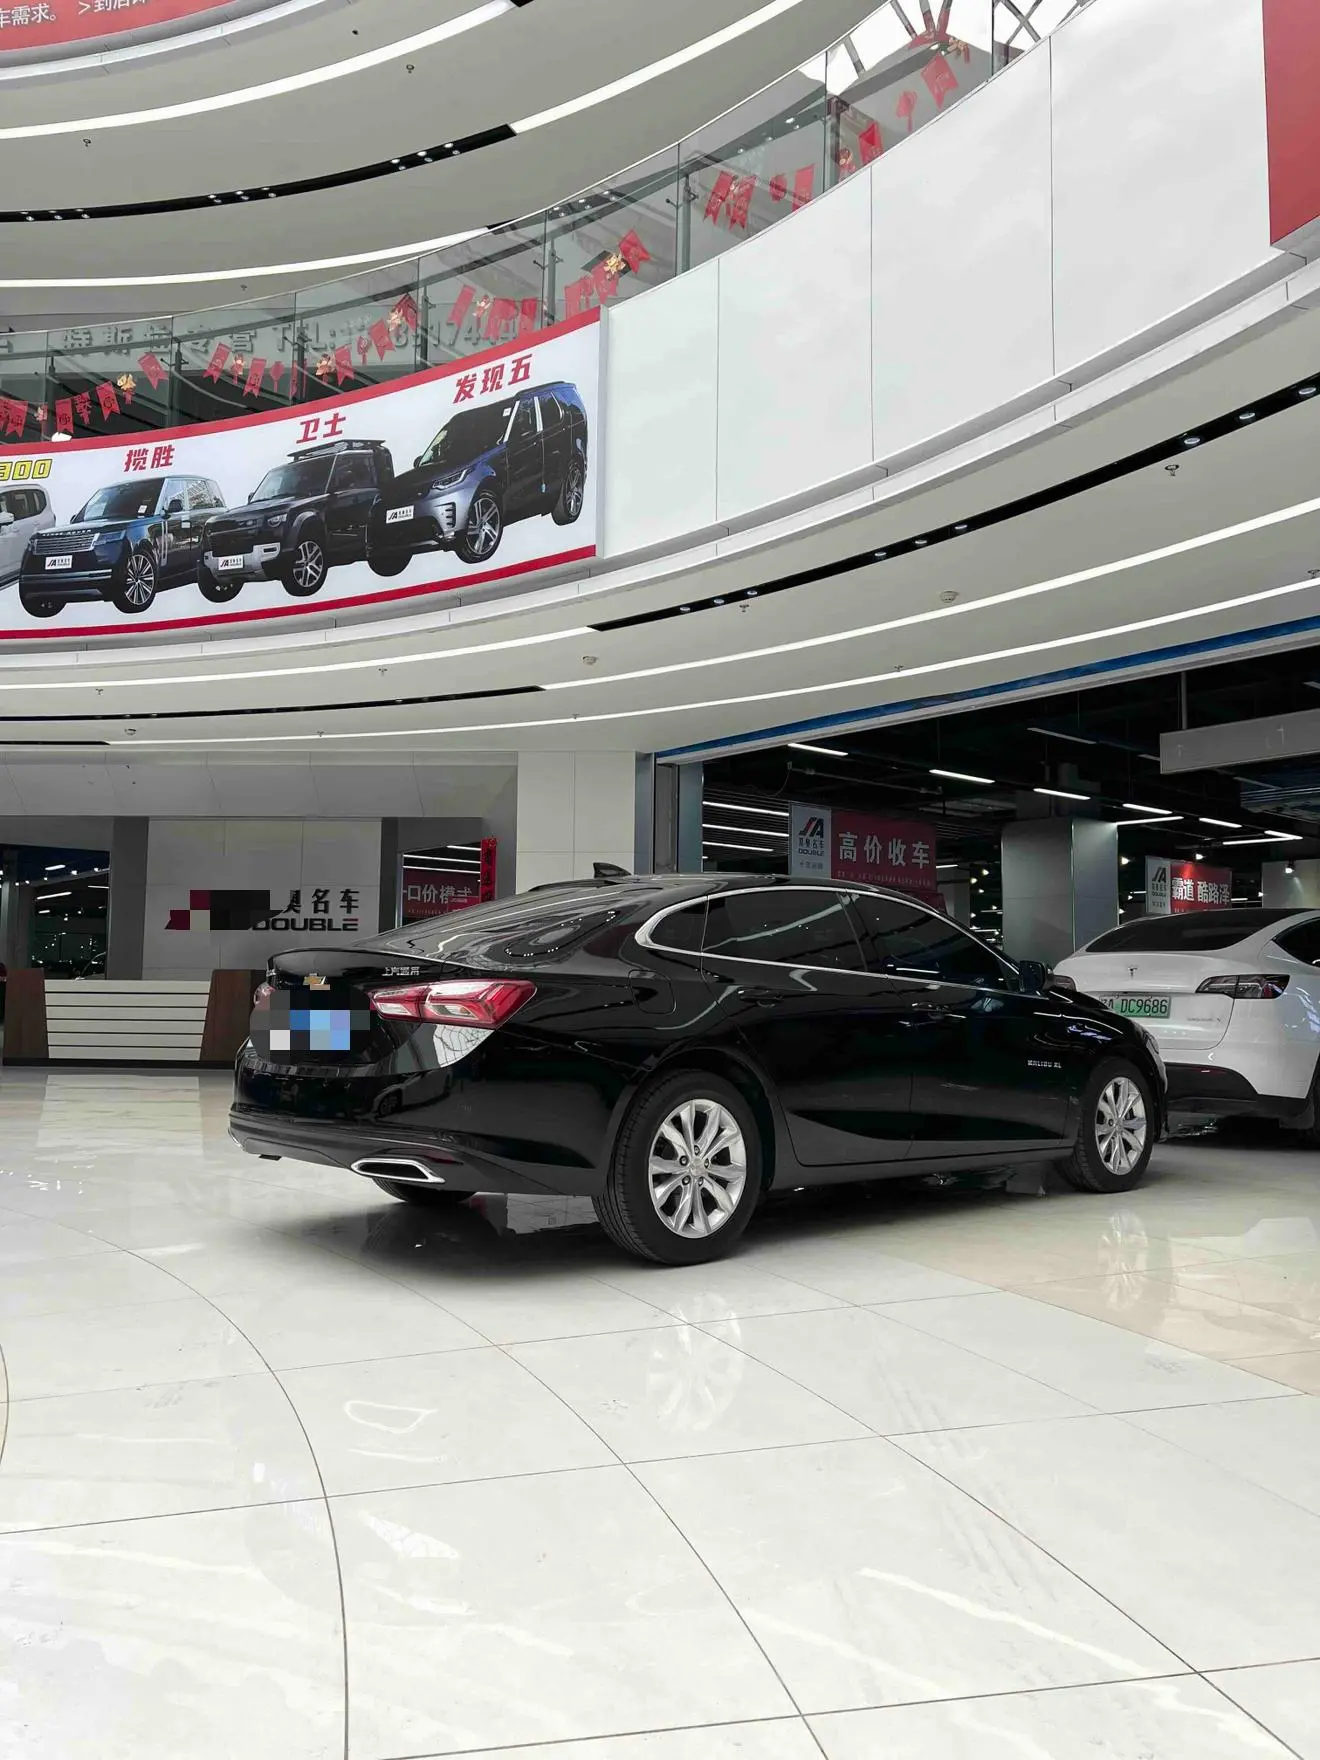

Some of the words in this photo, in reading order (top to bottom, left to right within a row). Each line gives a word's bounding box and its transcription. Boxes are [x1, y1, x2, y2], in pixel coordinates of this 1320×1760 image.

[452, 354, 534, 404] 发现五
[296, 412, 347, 444] 卫士
[124, 444, 175, 472] 揽胜
[838, 831, 930, 869] 高价收车
[1172, 877, 1195, 901] 霸道
[1197, 881, 1230, 905] 酷路泽
[252, 918, 359, 932] DOUBLE
[1120, 998, 1168, 1014] DC9686
